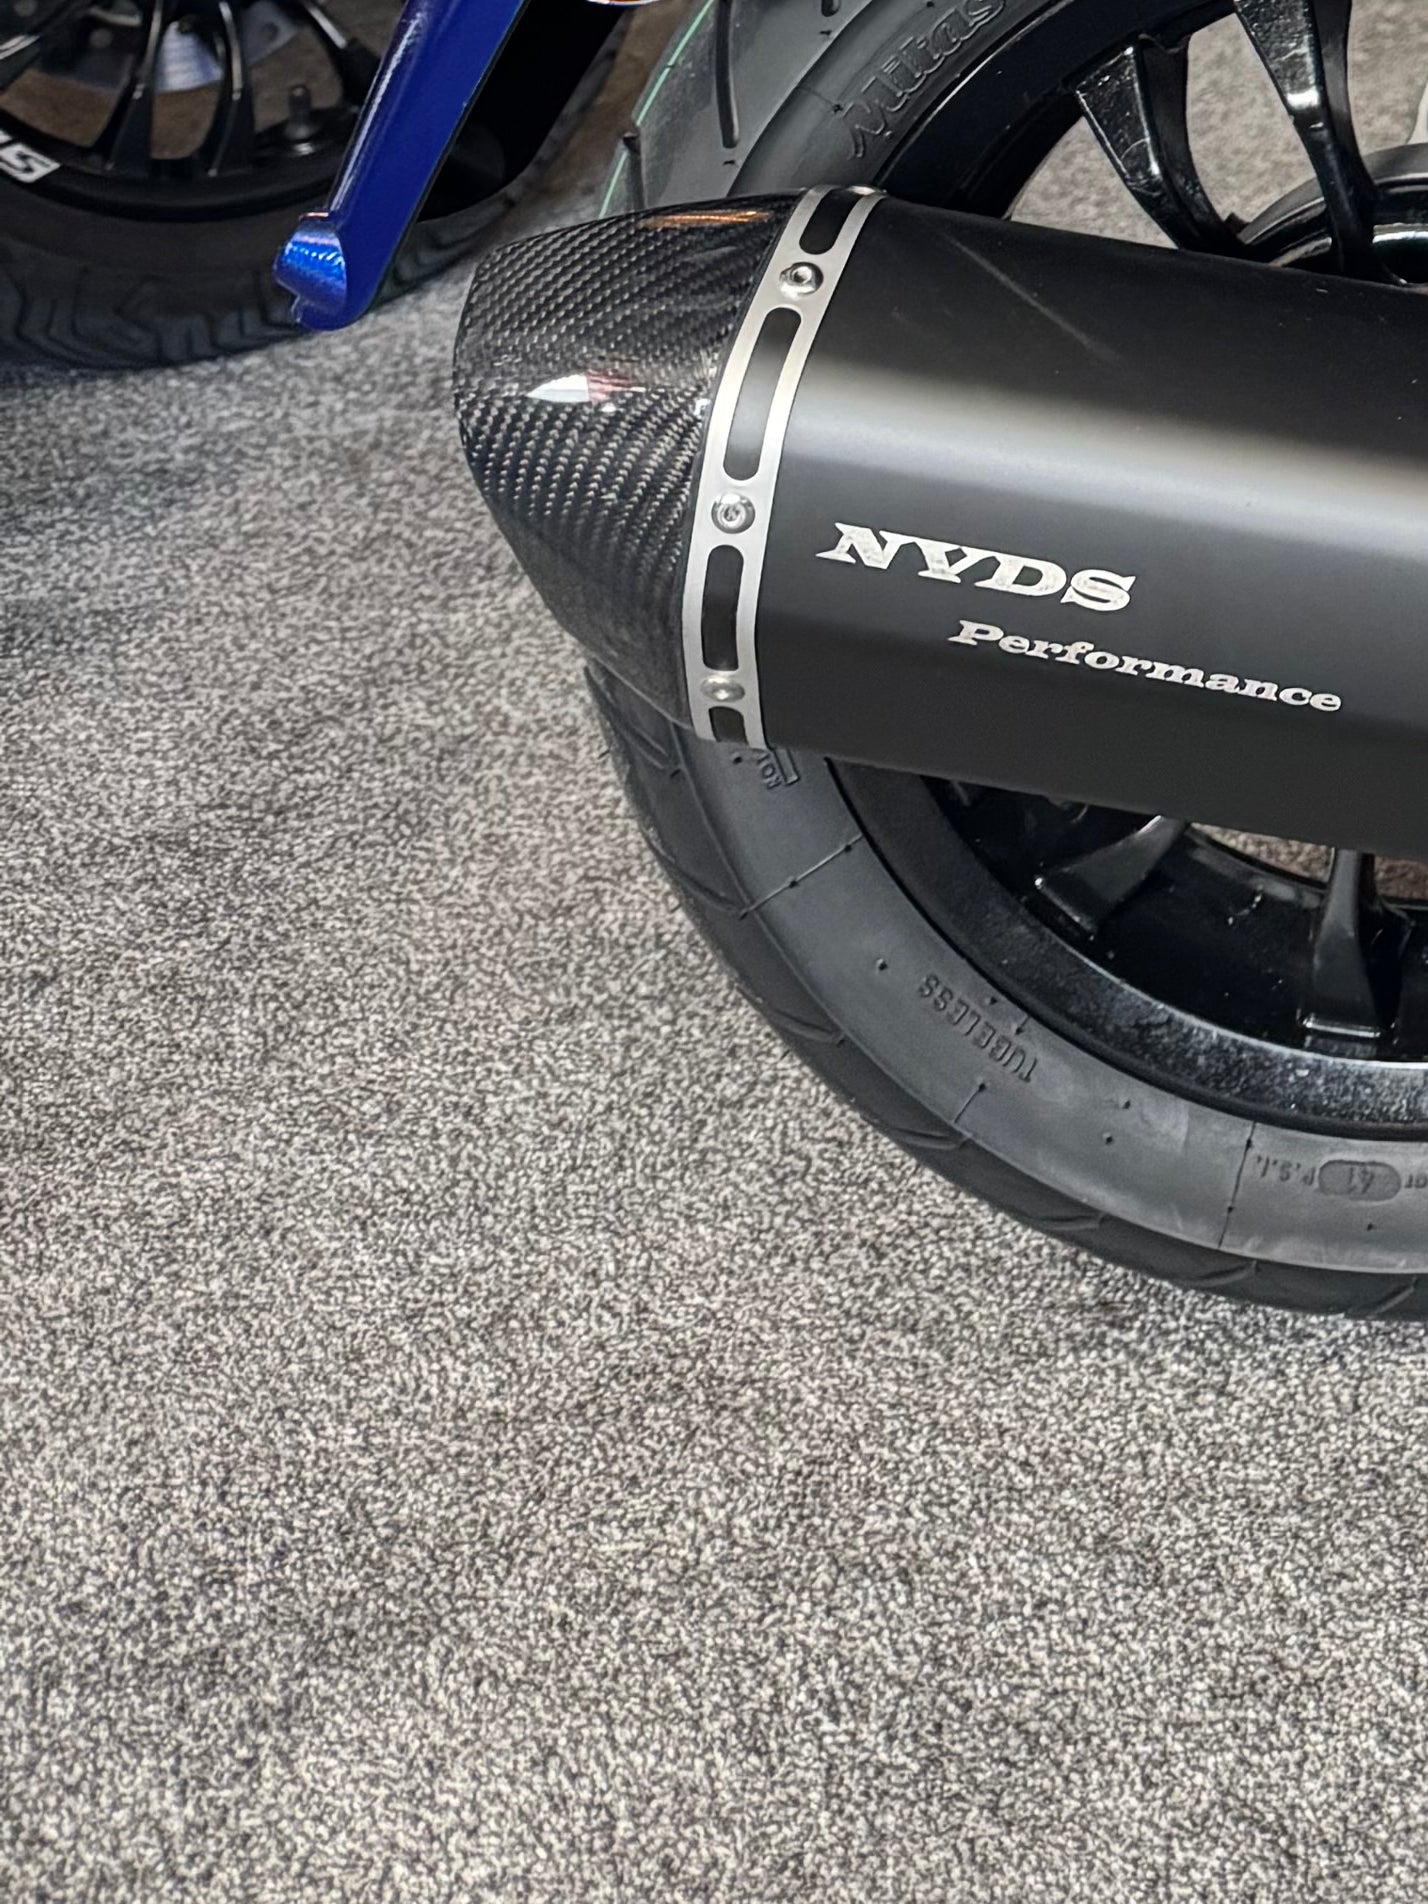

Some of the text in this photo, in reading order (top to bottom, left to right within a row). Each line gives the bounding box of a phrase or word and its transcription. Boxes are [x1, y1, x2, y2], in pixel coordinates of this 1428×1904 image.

[815, 522, 1136, 612] NYDS
[947, 619, 1342, 713] Performance
[917, 971, 1039, 1085] TUBELESS
